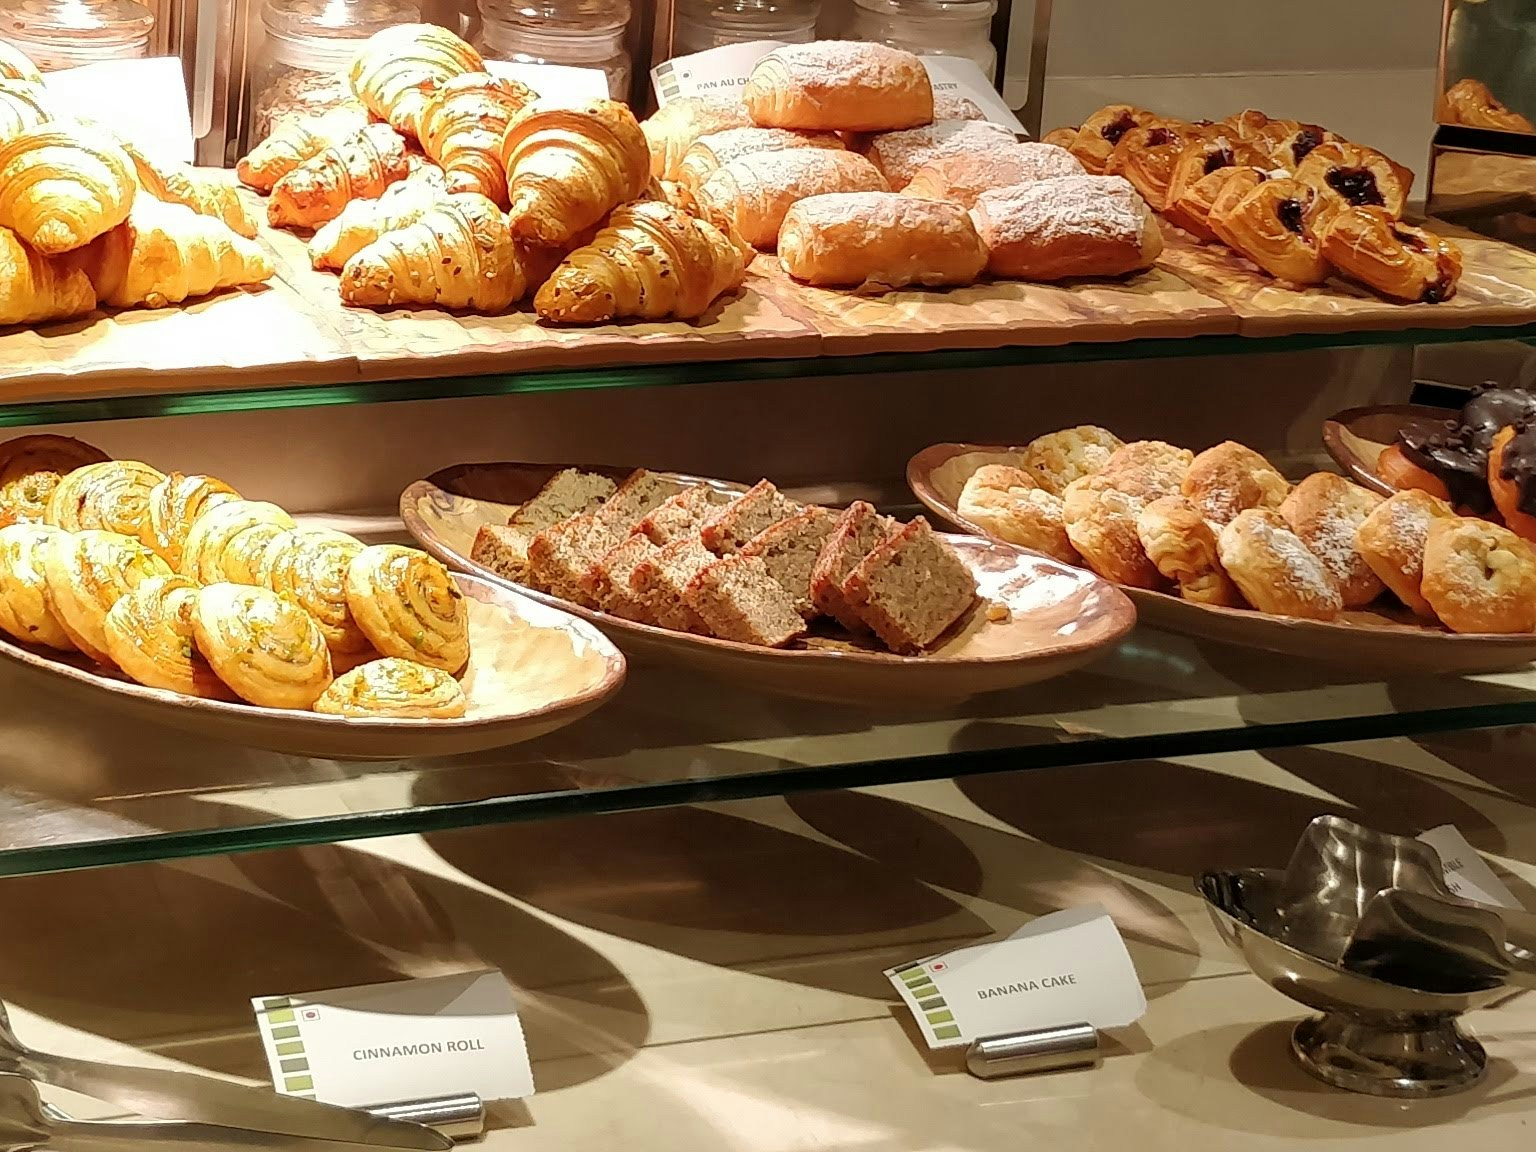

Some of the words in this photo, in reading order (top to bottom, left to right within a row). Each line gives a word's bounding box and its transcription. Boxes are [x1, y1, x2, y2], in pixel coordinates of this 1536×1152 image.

[977, 979, 1040, 1000] BANANA
[1041, 973, 1077, 989] CAKE
[352, 1041, 442, 1061] CINNAMON
[447, 1038, 485, 1052] ROLL
